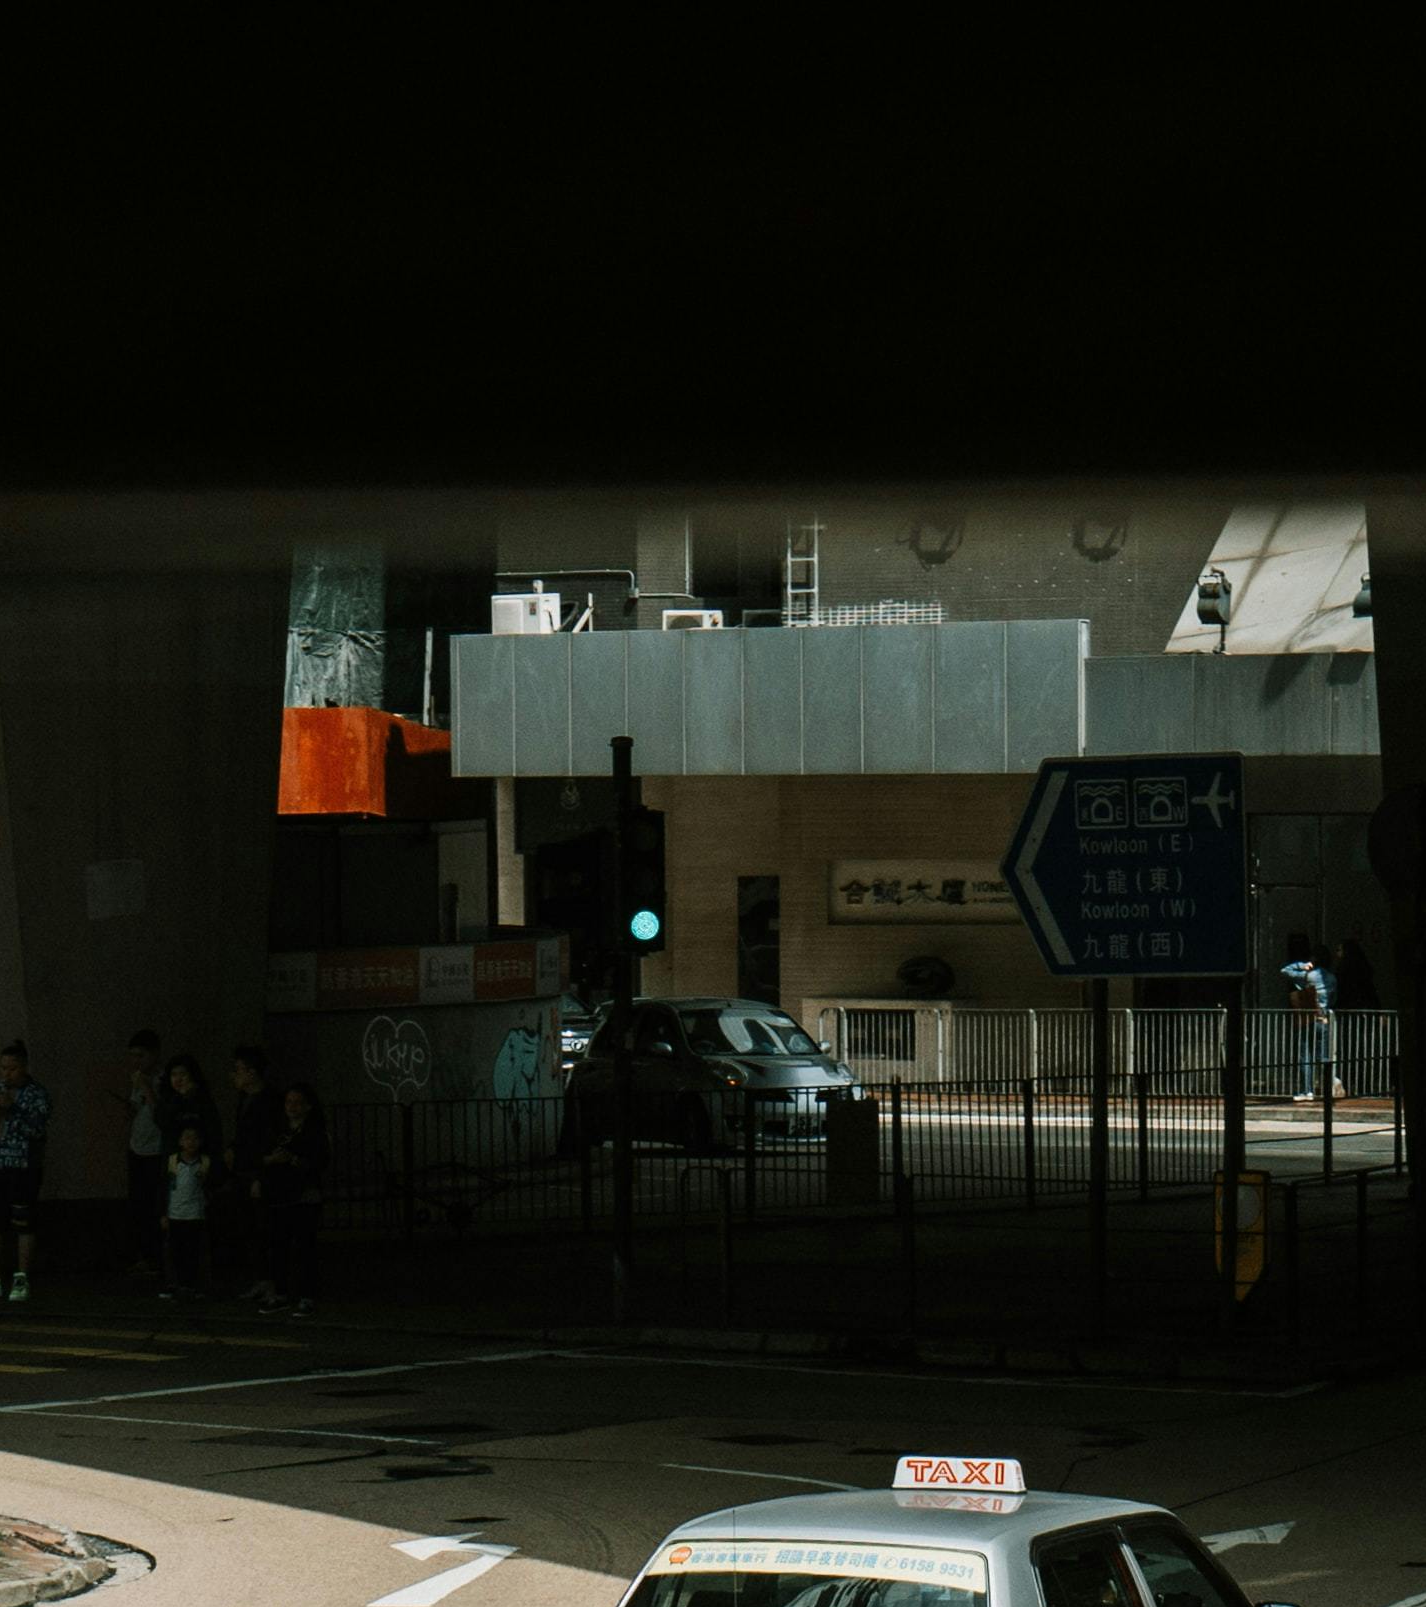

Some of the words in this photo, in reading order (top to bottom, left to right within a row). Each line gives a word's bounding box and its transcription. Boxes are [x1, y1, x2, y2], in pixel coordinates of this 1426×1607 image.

[1078, 835, 1149, 855] Kowloon
[1080, 900, 1150, 920] Kowloon
[907, 1460, 1005, 1485] TAXI
[939, 1561, 974, 1579] 9531
